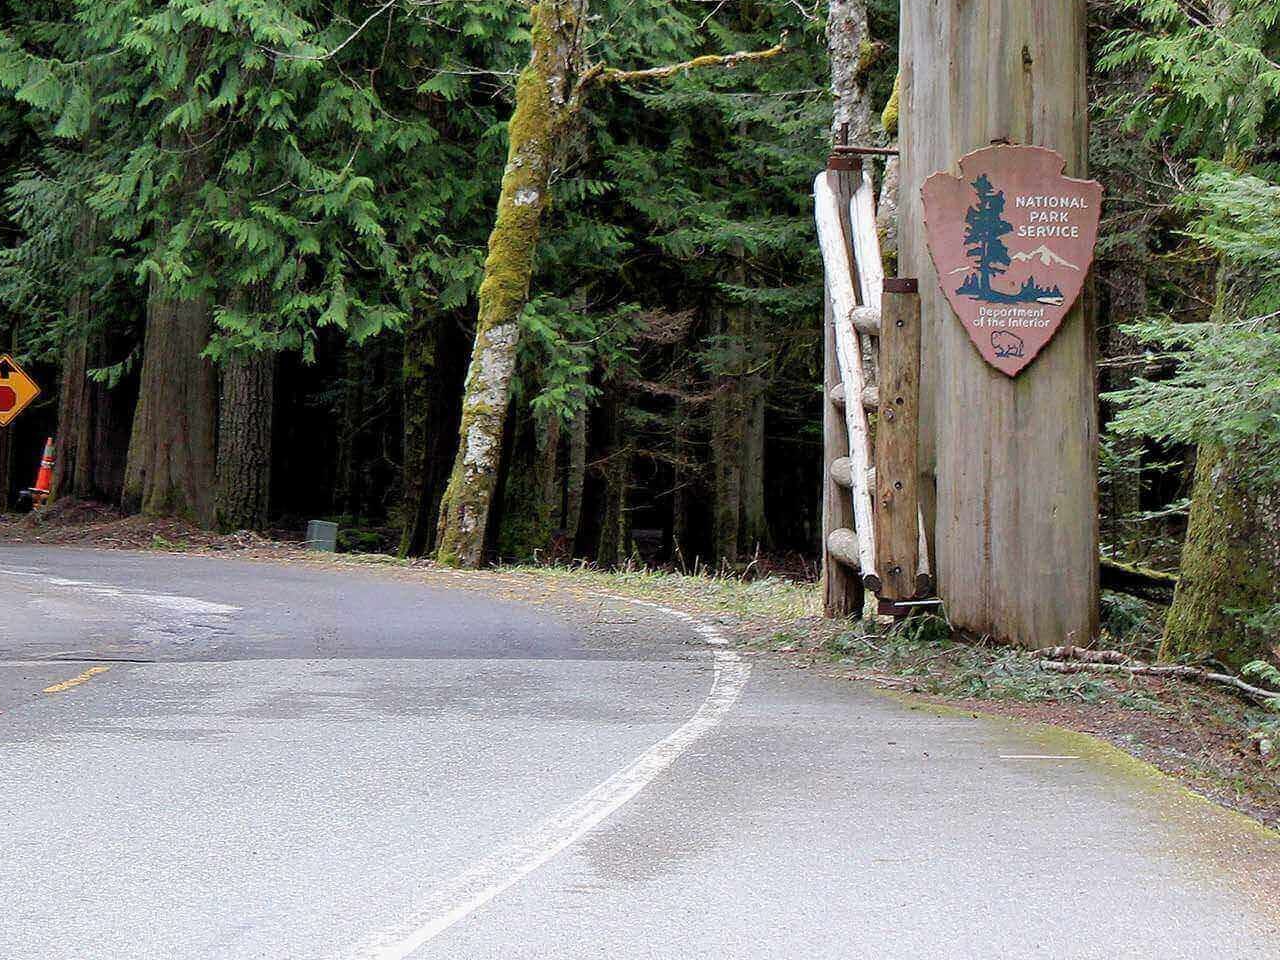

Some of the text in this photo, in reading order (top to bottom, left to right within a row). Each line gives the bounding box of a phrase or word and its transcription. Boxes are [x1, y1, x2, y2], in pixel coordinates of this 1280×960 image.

[1015, 196, 1089, 209] NATIONAL
[1030, 211, 1069, 223] PARK
[1017, 225, 1079, 238] SERVICE
[979, 306, 1044, 318] Department
[972, 317, 1051, 328] of the Interior
